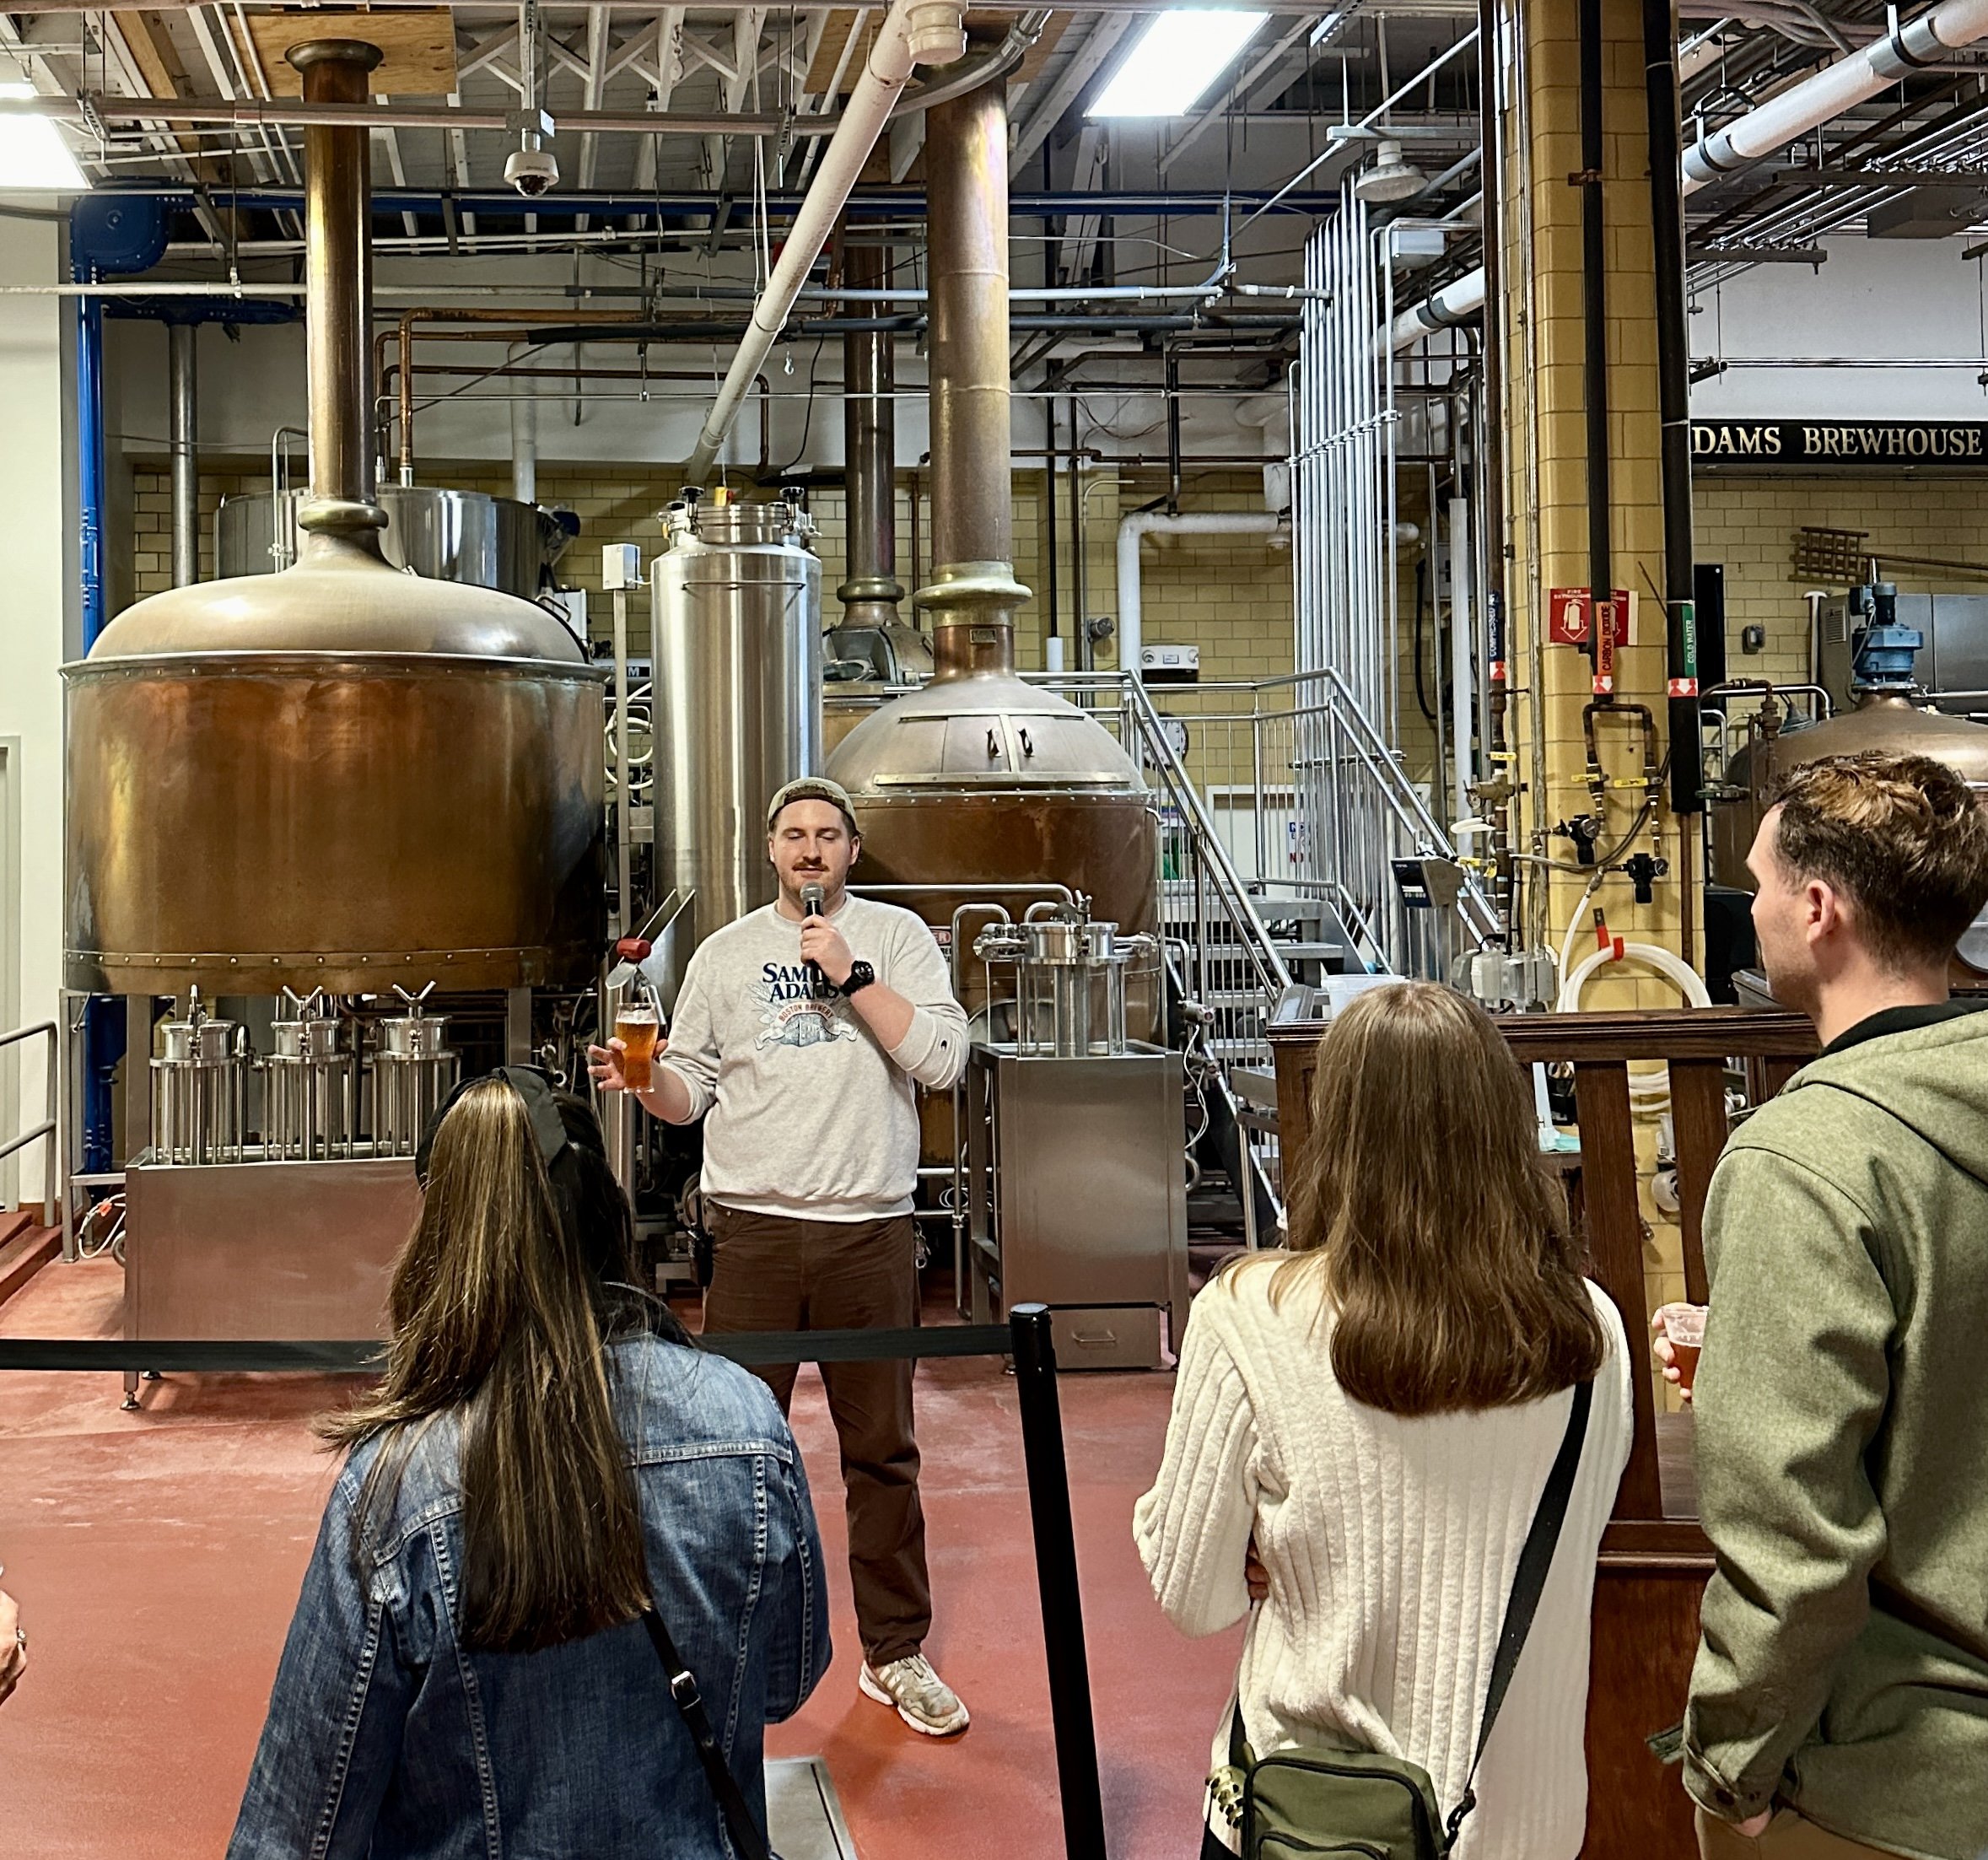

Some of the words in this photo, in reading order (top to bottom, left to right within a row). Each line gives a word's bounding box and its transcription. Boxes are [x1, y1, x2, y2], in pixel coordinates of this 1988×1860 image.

[1691, 427, 1782, 455] DAMS
[1802, 427, 1983, 456] BREWHOUSE
[1601, 605, 1610, 635] DIOXIDE
[1685, 619, 1694, 643] WATER
[1602, 639, 1612, 671] CARBON
[769, 983, 840, 1002] ADAS
[778, 1004, 803, 1022] BOSTON
[805, 1003, 835, 1019] BREWERY
